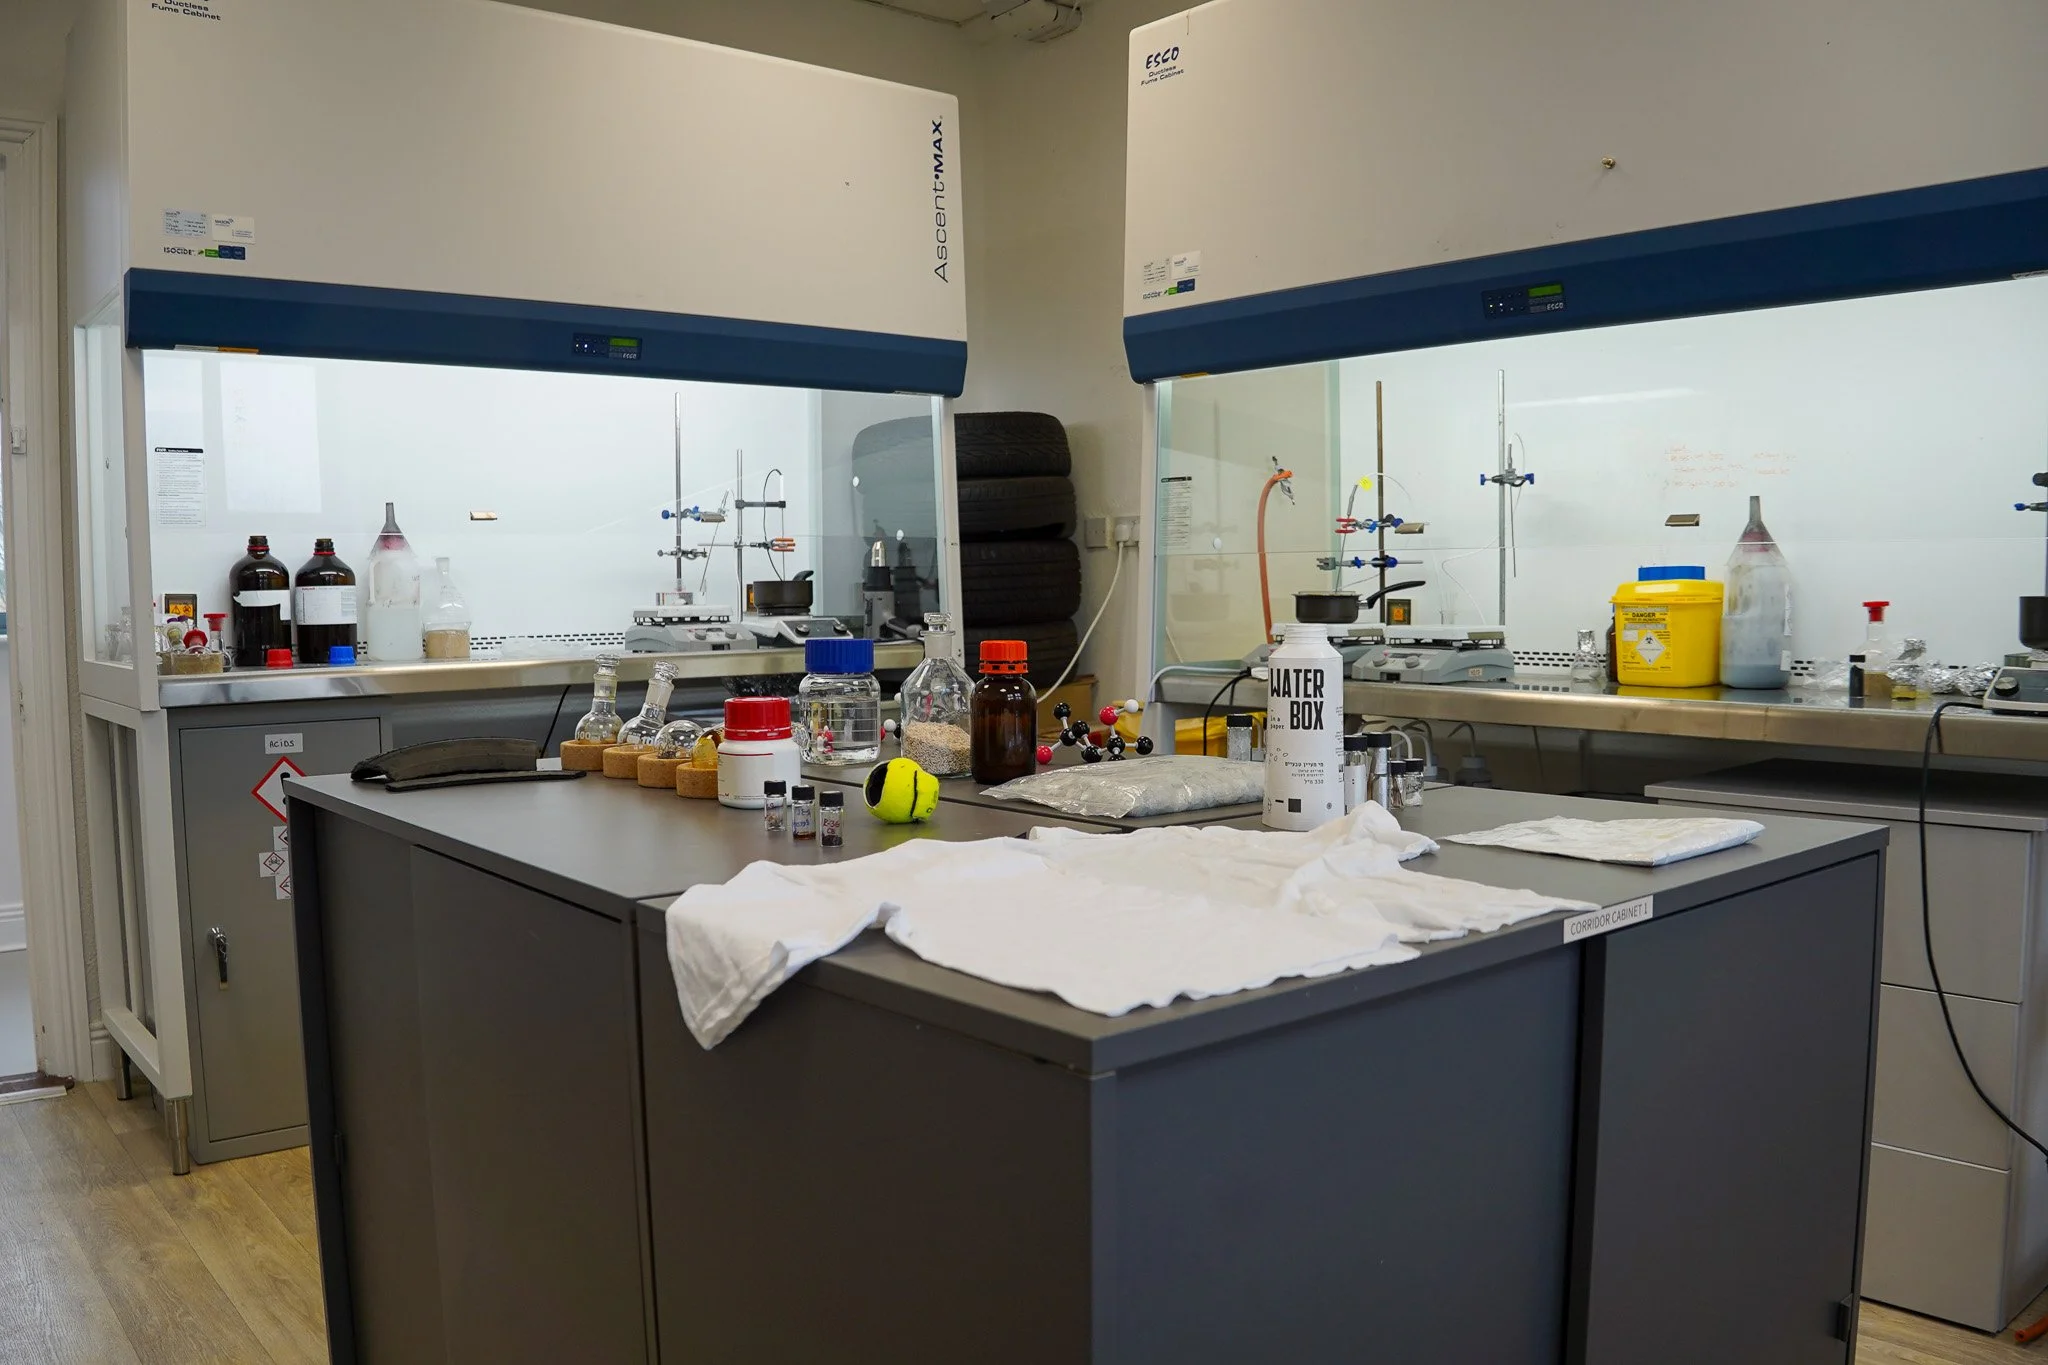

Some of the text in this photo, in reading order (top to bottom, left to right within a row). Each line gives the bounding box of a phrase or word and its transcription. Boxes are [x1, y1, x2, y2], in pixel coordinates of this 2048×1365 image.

[151, 3, 222, 21] Fume Cabinet
[1145, 46, 1180, 70] ESCO
[1159, 68, 1185, 80] Cabinet
[1270, 668, 1325, 698] WATER
[1289, 700, 1324, 731] BOX
[1570, 914, 1610, 936] CORRIDOR
[1611, 903, 1643, 924] CABINET
